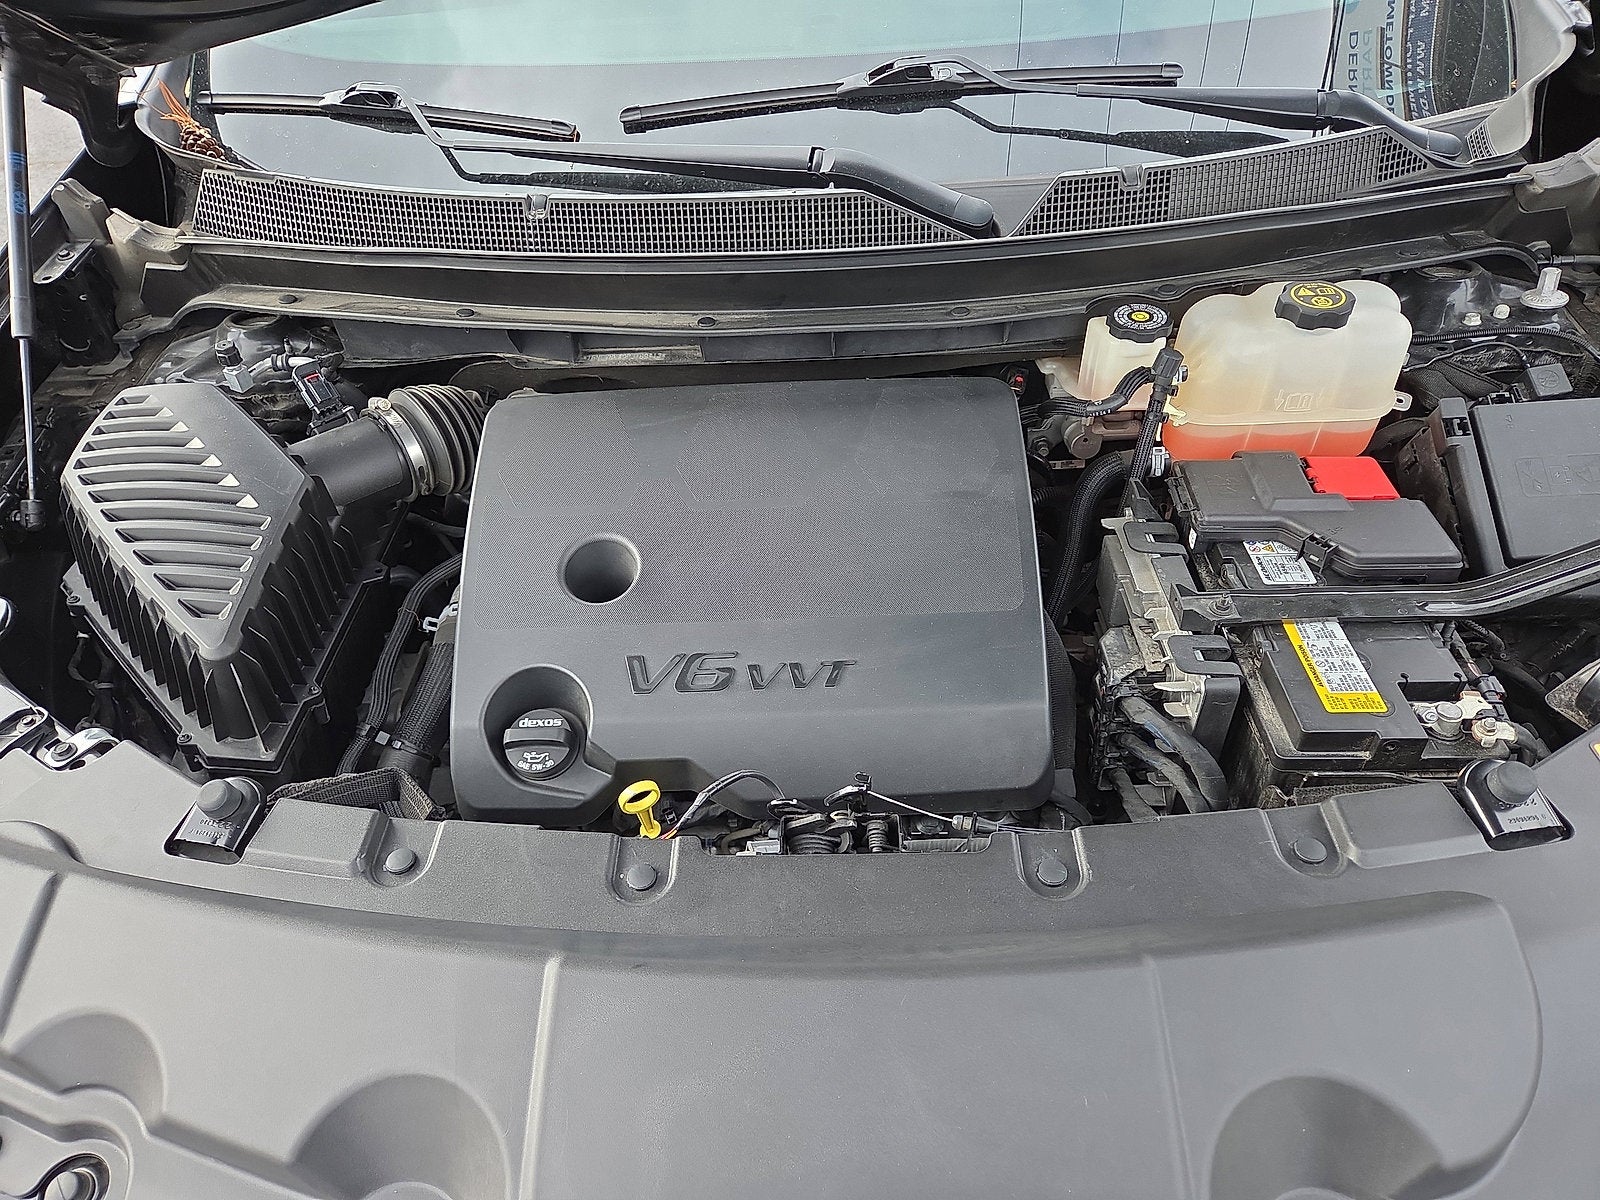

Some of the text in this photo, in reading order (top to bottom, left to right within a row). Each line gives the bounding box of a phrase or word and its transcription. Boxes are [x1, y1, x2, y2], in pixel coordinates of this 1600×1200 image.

[624, 651, 858, 695] V6 VVT
[518, 717, 563, 728] dexos
[517, 759, 555, 771] SAE 5W-30
